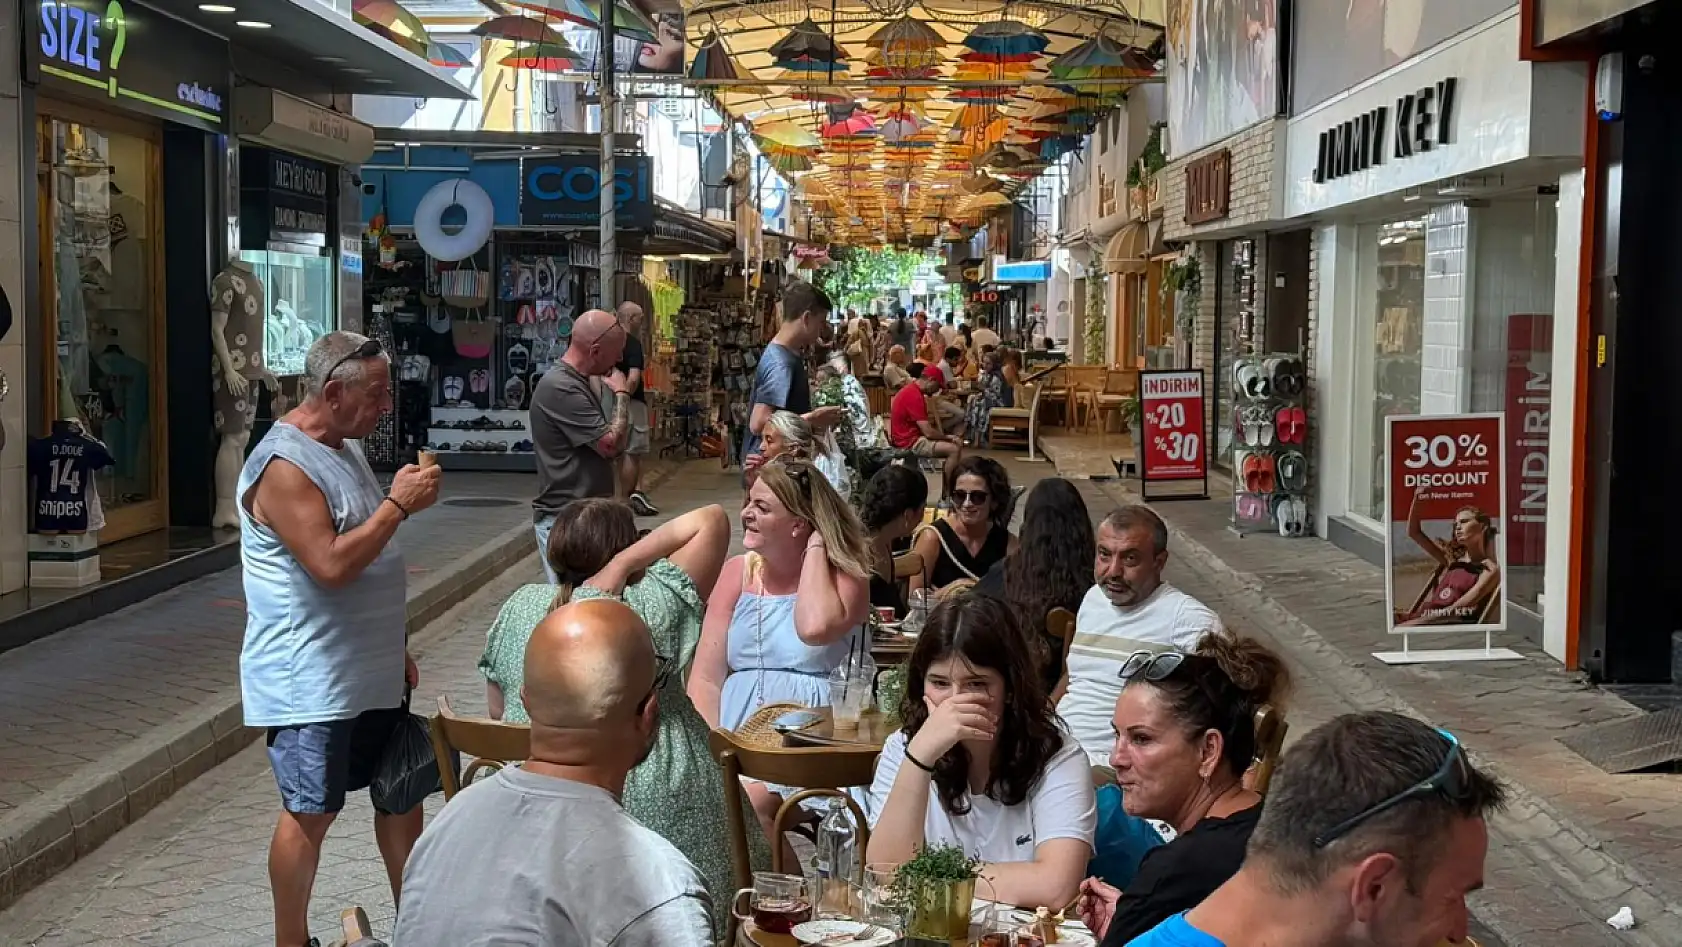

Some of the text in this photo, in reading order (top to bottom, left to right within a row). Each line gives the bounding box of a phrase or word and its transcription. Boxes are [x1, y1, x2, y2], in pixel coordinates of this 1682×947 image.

[1312, 77, 1458, 183] JIMMY KEY
[1146, 402, 1186, 429] %20
[1154, 431, 1199, 462] %30
[49, 458, 80, 494] 14
[1404, 471, 1489, 487] DISCOUNT
[1420, 606, 1474, 618] JIMMY KEY
